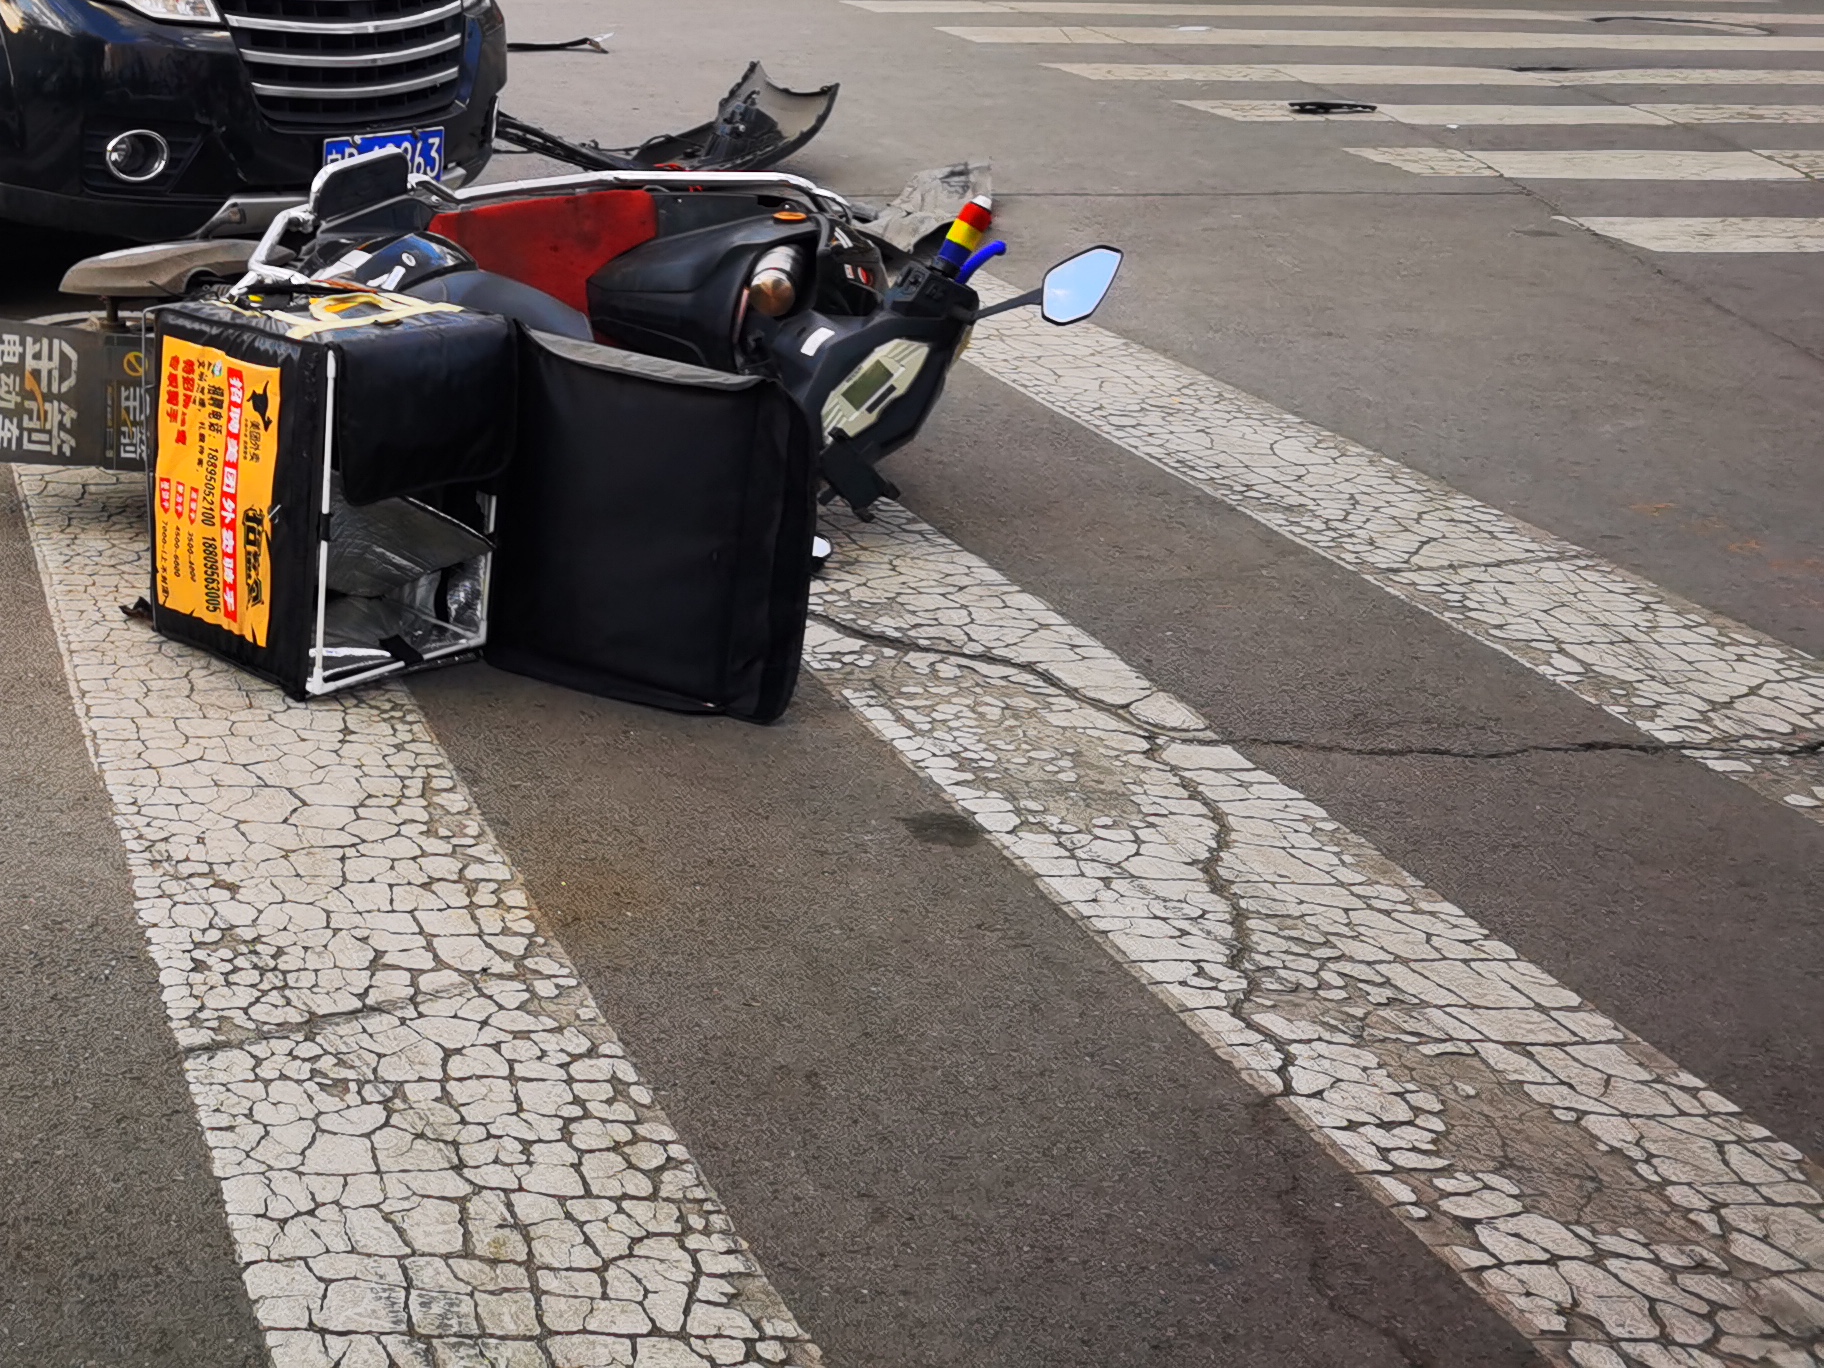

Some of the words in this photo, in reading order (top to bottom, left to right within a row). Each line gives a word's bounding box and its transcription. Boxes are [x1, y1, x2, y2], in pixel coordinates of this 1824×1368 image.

[23, 336, 78, 457] 金箭
[249, 420, 262, 463] 美团外卖
[202, 447, 219, 527] 18895052100
[221, 377, 244, 612] 招聘美团外卖骑手
[202, 536, 221, 613] 18809563005
